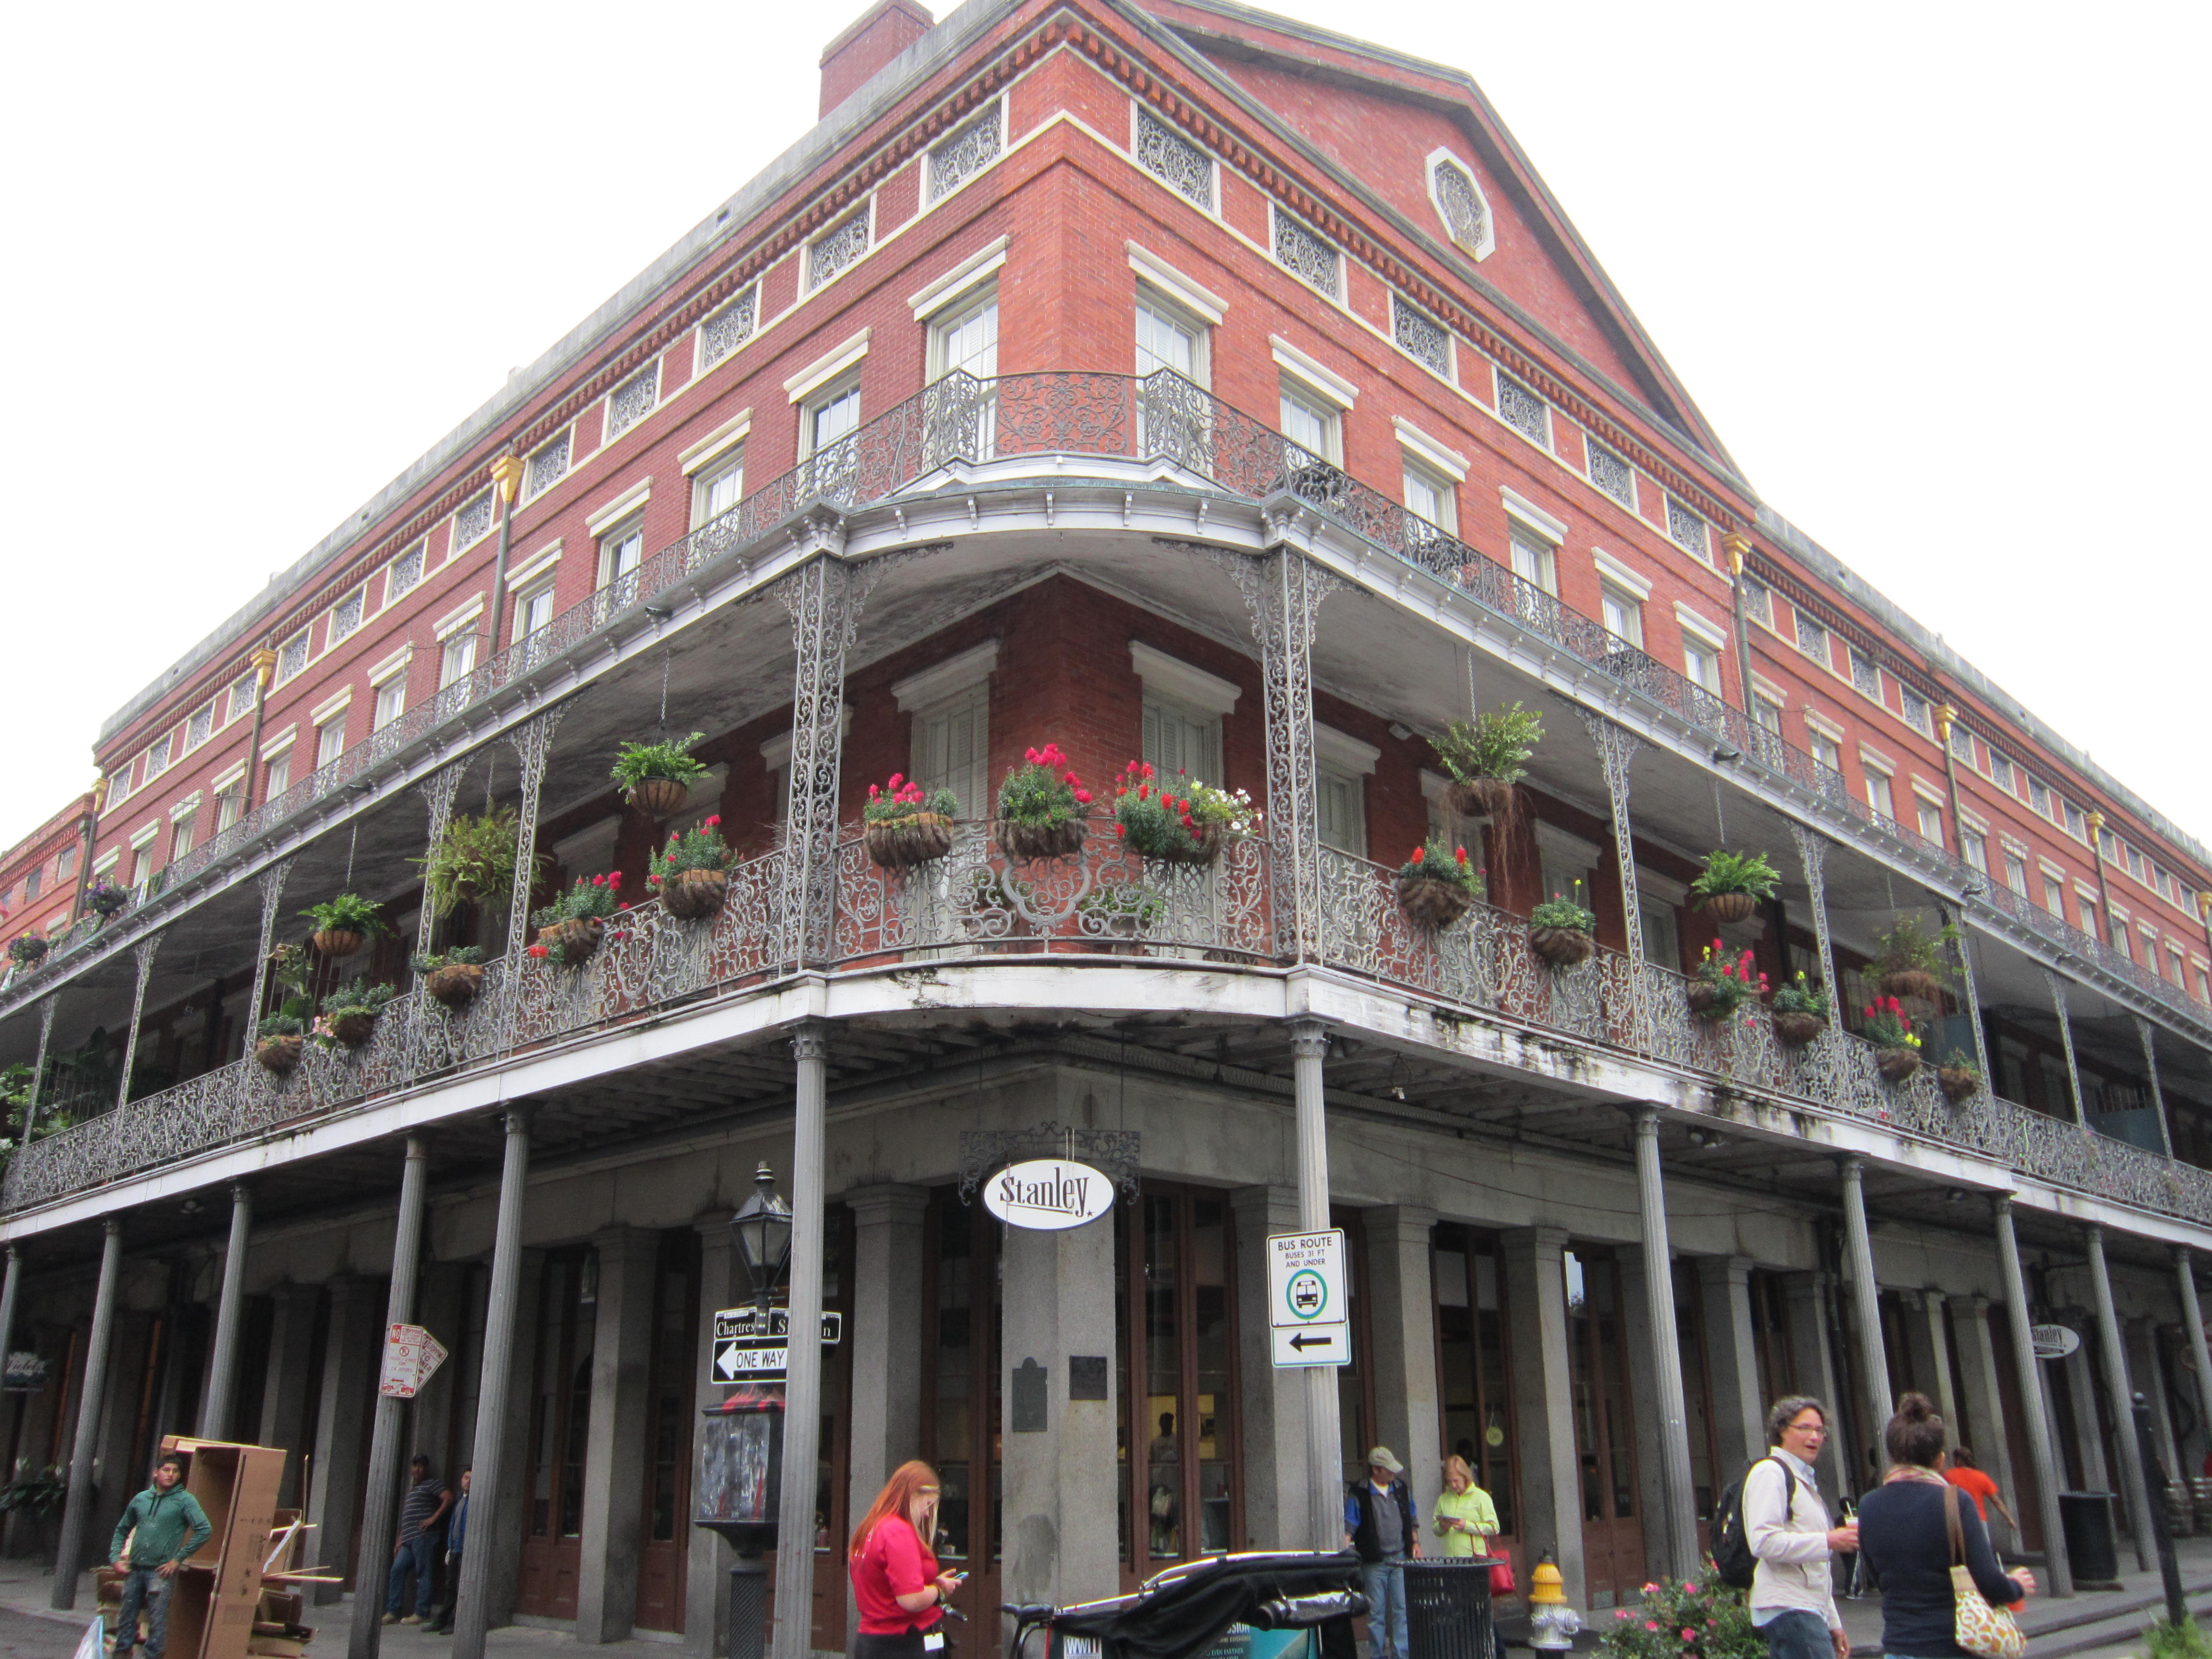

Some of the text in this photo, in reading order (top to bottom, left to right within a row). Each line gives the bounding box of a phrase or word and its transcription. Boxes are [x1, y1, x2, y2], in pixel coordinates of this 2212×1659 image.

[1000, 1167, 1090, 1217] Stanley
[1278, 1237, 1332, 1251] BUS ROUTE
[1286, 1251, 1304, 1259] BUSES
[1304, 1258, 1326, 1266] UNDER
[392, 1329, 400, 1340] NO
[717, 1321, 755, 1336] Chartres
[422, 1352, 430, 1361] TO
[736, 1350, 785, 1368] ONE WAY
[1066, 1637, 1097, 1655] WWII
